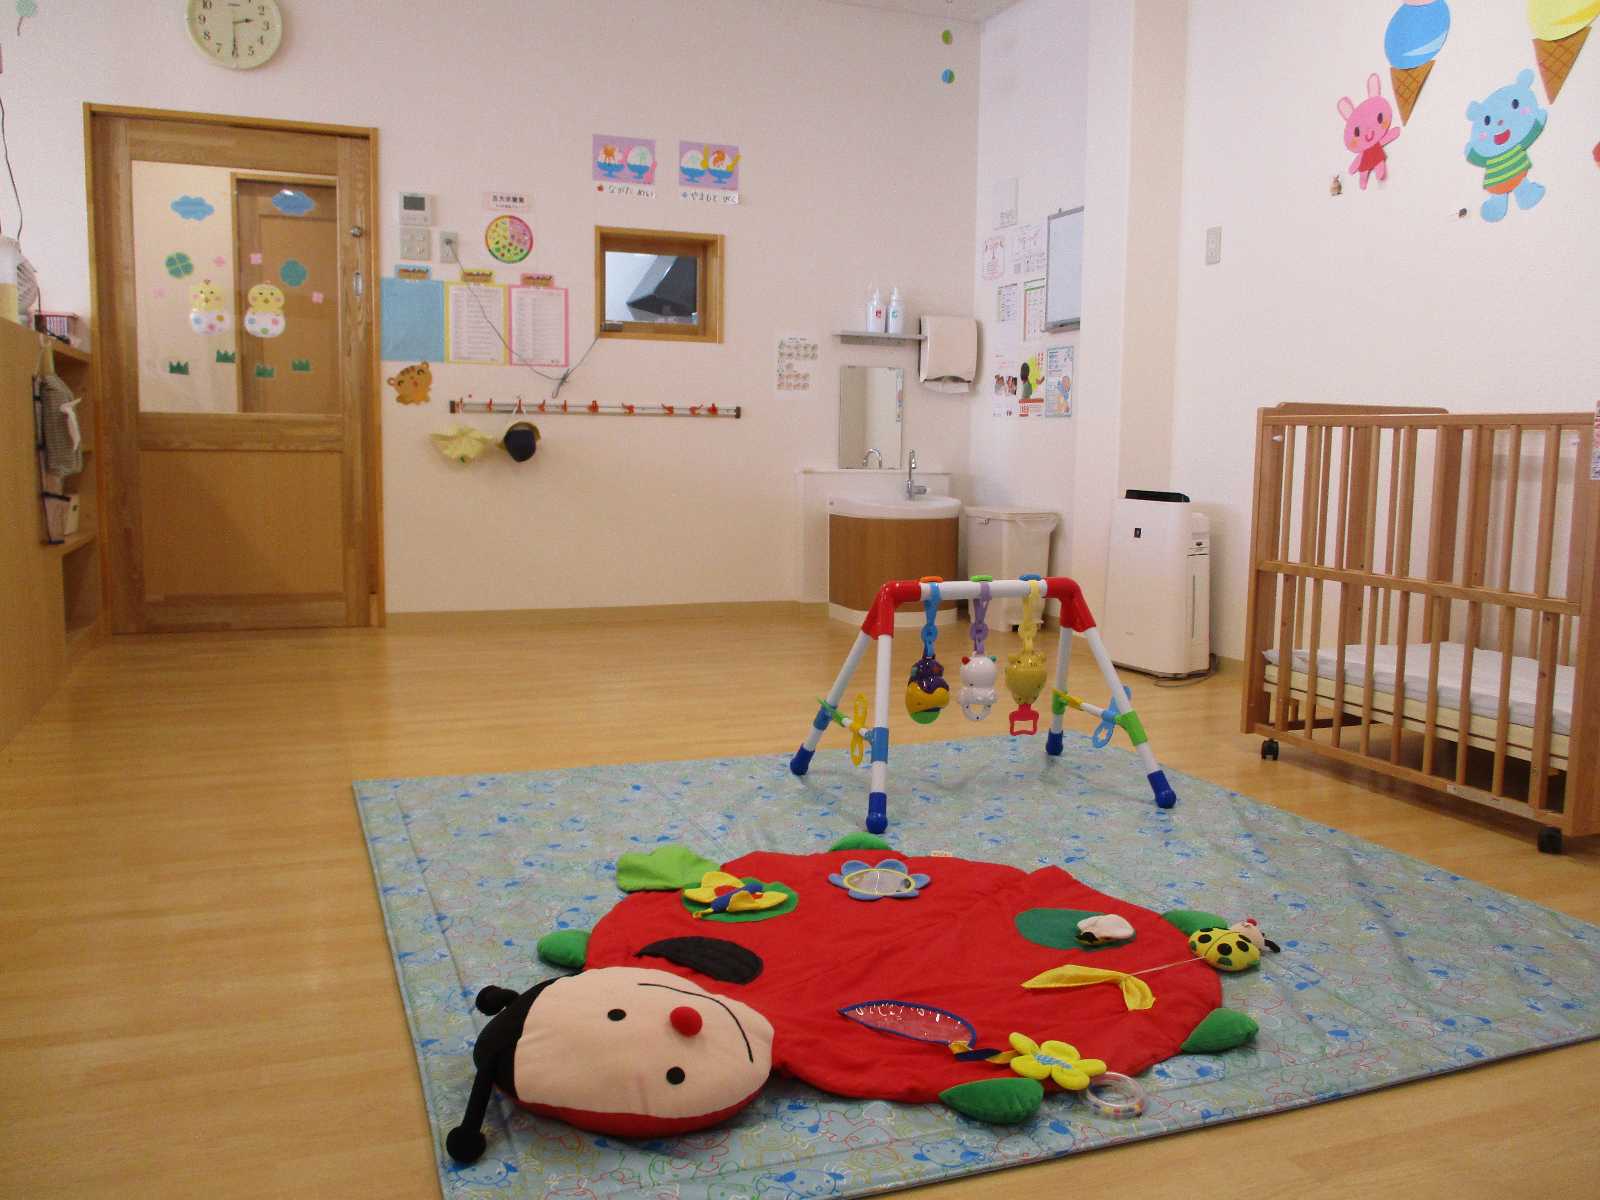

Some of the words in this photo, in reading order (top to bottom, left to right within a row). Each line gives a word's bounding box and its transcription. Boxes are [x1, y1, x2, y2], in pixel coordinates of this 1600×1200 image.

[202, 0, 212, 9] 10
[257, 5, 264, 15] 2
[198, 15, 206, 24] 9
[262, 21, 269, 31] 3
[203, 31, 211, 40] 8
[257, 35, 264, 45] 4
[215, 42, 222, 53] 7
[248, 46, 254, 56] 5
